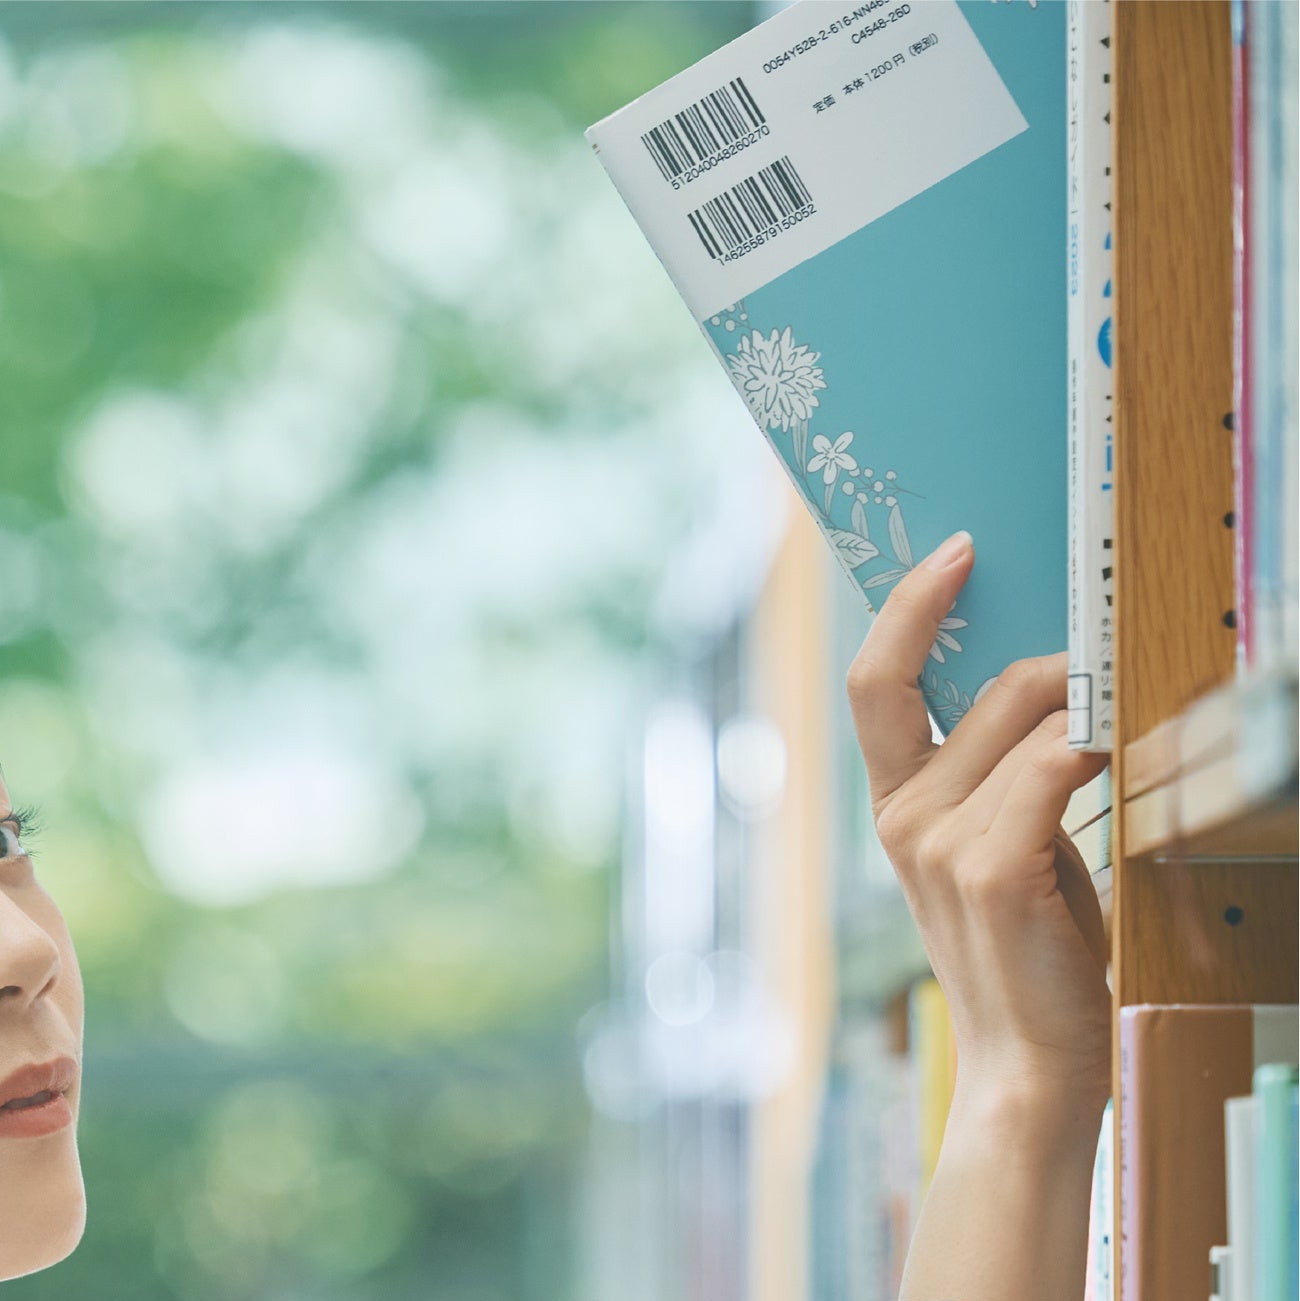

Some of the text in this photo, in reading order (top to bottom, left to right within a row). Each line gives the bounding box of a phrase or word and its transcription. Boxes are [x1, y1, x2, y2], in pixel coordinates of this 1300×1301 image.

[851, 4, 911, 45] C4548-26D
[671, 125, 770, 190] 512040048260270
[717, 204, 817, 267] 146255879150052
